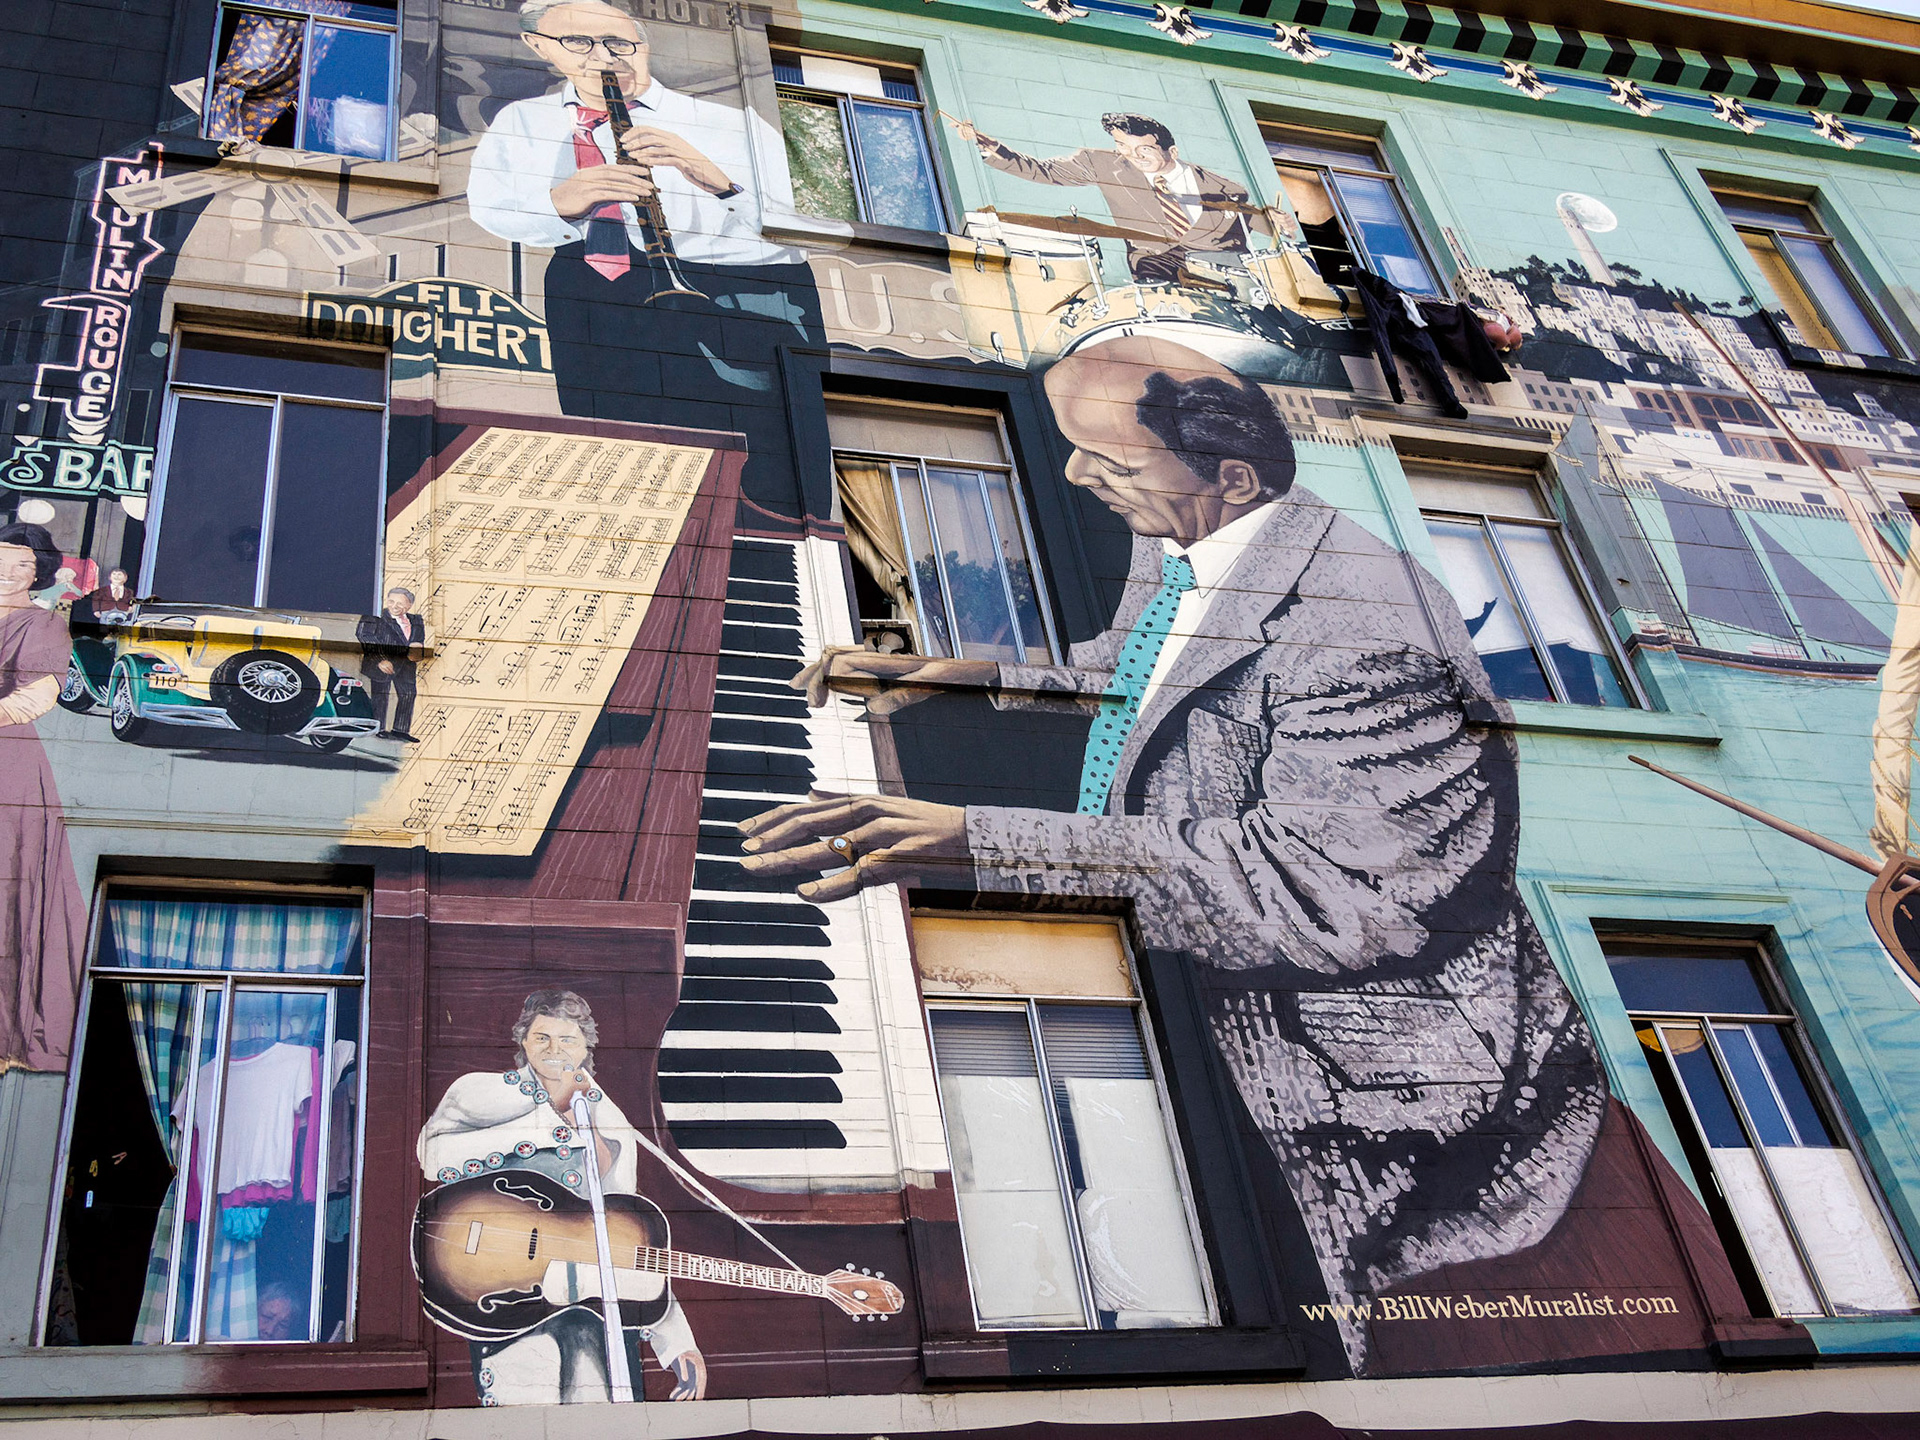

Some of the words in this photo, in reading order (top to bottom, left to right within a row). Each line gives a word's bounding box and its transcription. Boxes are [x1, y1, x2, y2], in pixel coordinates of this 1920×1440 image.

[101, 166, 150, 290] MULIN
[77, 305, 122, 418] ROUGE
[155, 675, 178, 688] 110
[690, 1257, 740, 1282] TONY
[754, 1267, 823, 1294] KLAAS
[1300, 1292, 1679, 1321] www.BillWeberMuralist.com
